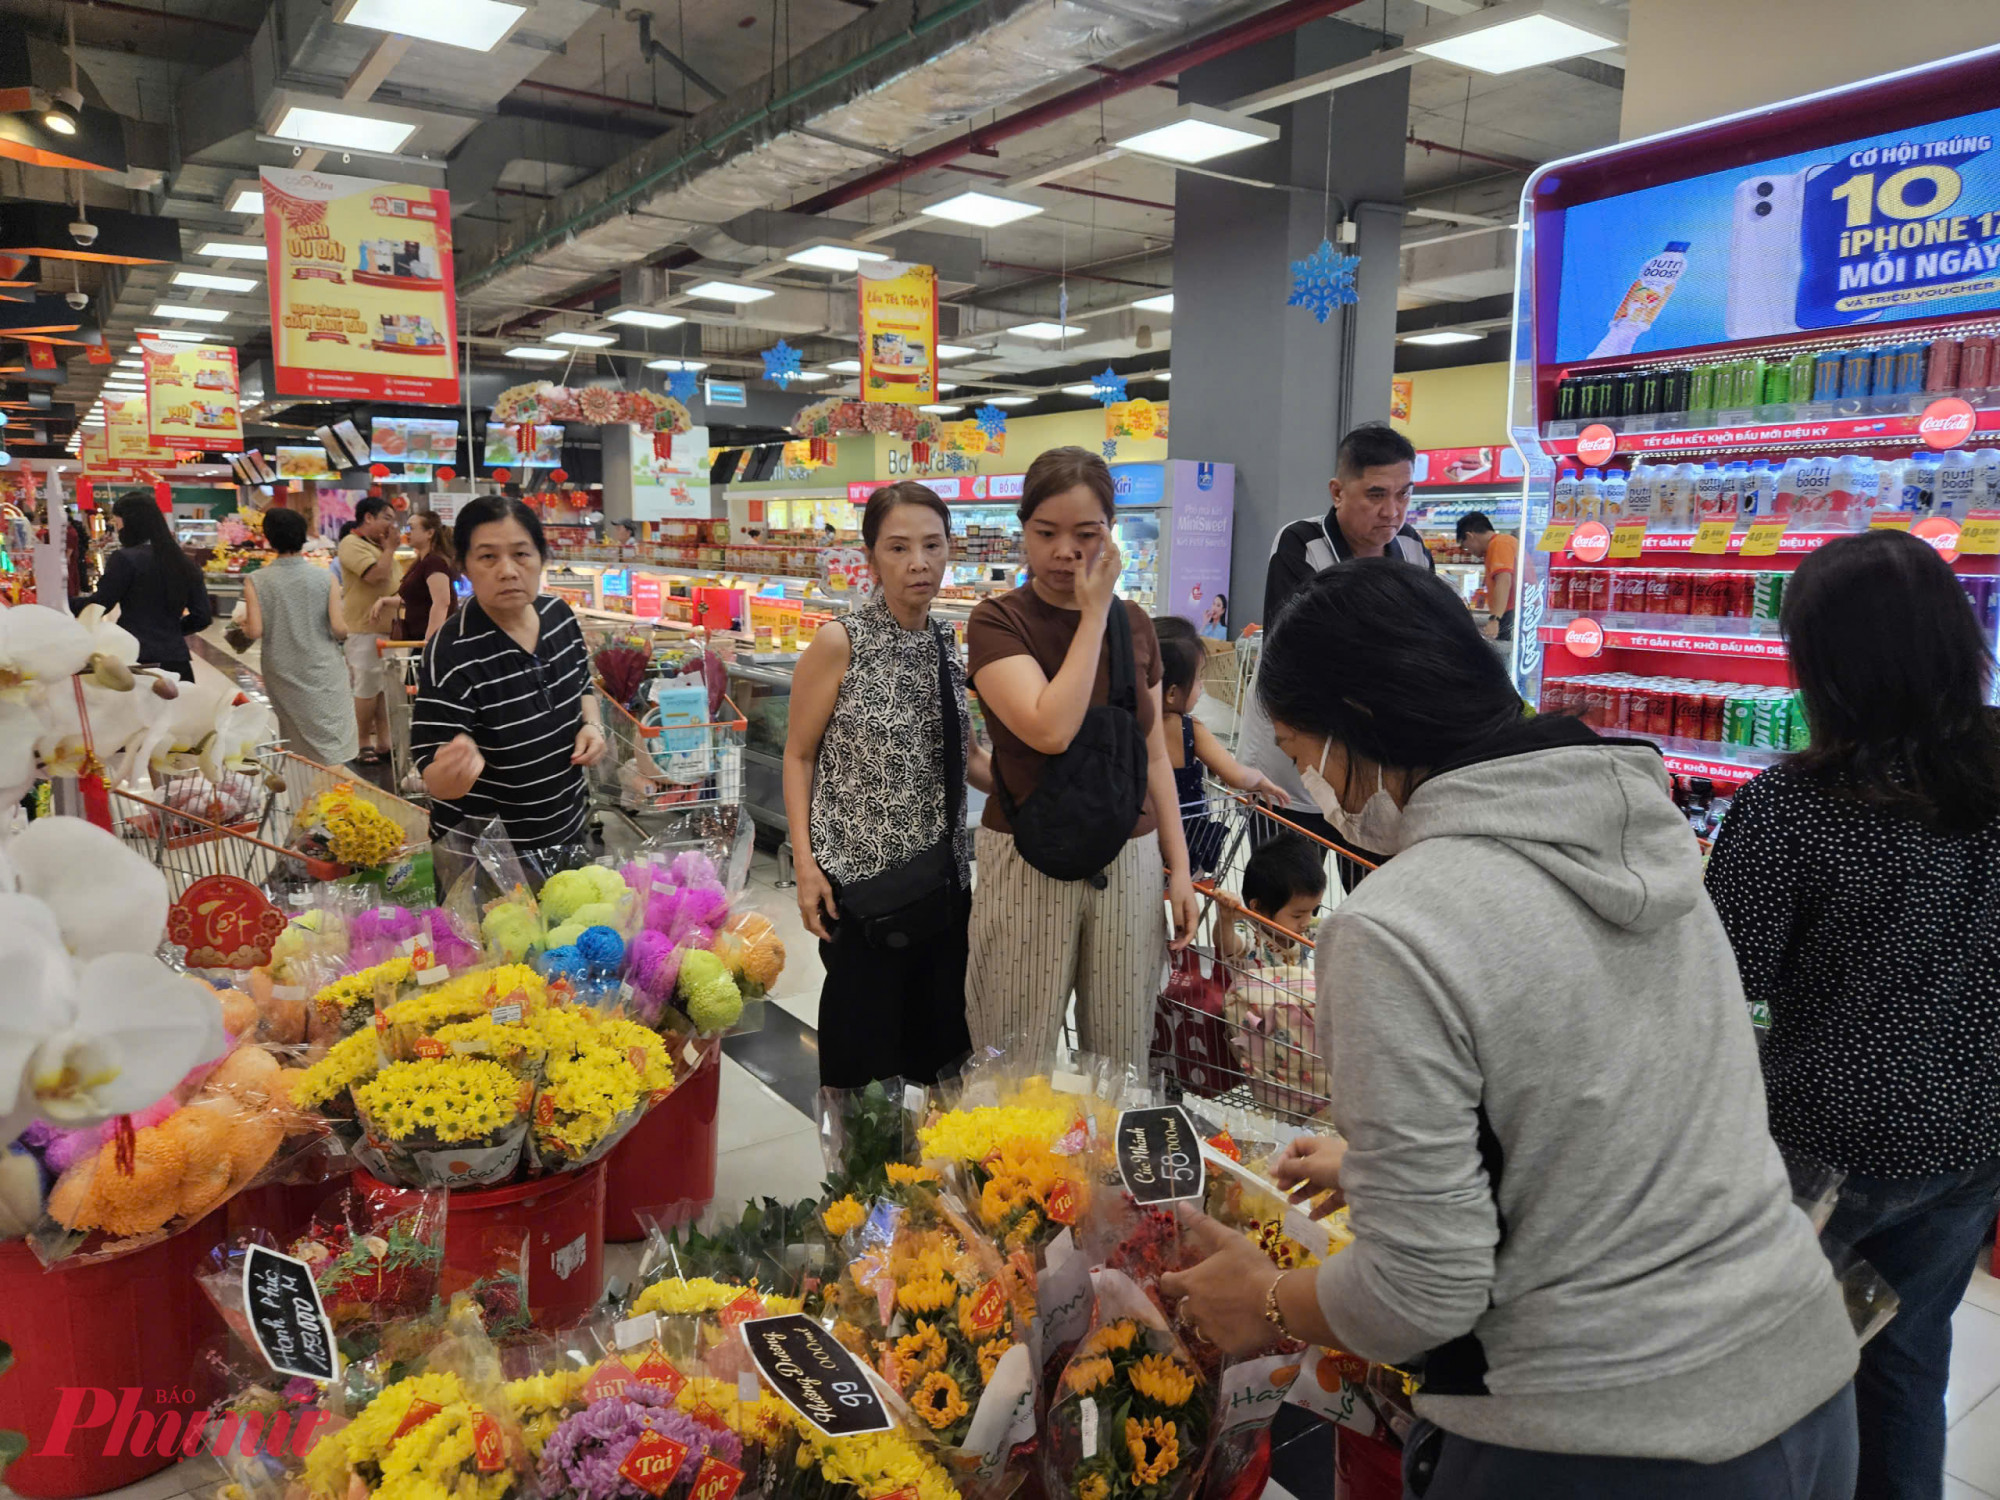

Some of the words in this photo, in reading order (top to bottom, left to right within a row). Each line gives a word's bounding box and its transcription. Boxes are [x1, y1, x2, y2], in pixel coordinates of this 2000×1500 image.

[1850, 147, 1879, 168] CƠ
[1881, 141, 1919, 165] HỘI
[1923, 135, 1992, 158] TRÚNG
[1832, 164, 1962, 228] 10
[1839, 214, 1970, 258] iPHONE
[1839, 252, 1906, 291] MỖI
[1915, 241, 2000, 280] NGÀY
[1915, 281, 1995, 298] VOUCHER
[1919, 413, 1970, 433] Coca-Cola
[1577, 436, 1612, 452] Coca-Cola
[1643, 435, 1662, 447] TẾT
[1662, 432, 1684, 446] GẮN
[1760, 429, 1782, 440] MỚI
[1783, 427, 1811, 439] DIỆU
[1796, 475, 1831, 488] boost
[1798, 466, 1831, 477] nutri
[1942, 479, 1974, 489] boost
[1572, 534, 1609, 549] Coca-Cola
[1565, 630, 1599, 644] Coca-Cola
[1630, 635, 1650, 646] TẾT
[1743, 643, 1766, 654] MỚI
[1766, 644, 1789, 657] DIỆ
[198, 899, 253, 946] Tết
[1125, 1127, 1150, 1163] Nhánh
[1132, 1162, 1156, 1184] Cúc
[831, 1380, 874, 1408] 99
[635, 1447, 675, 1477] Tài
